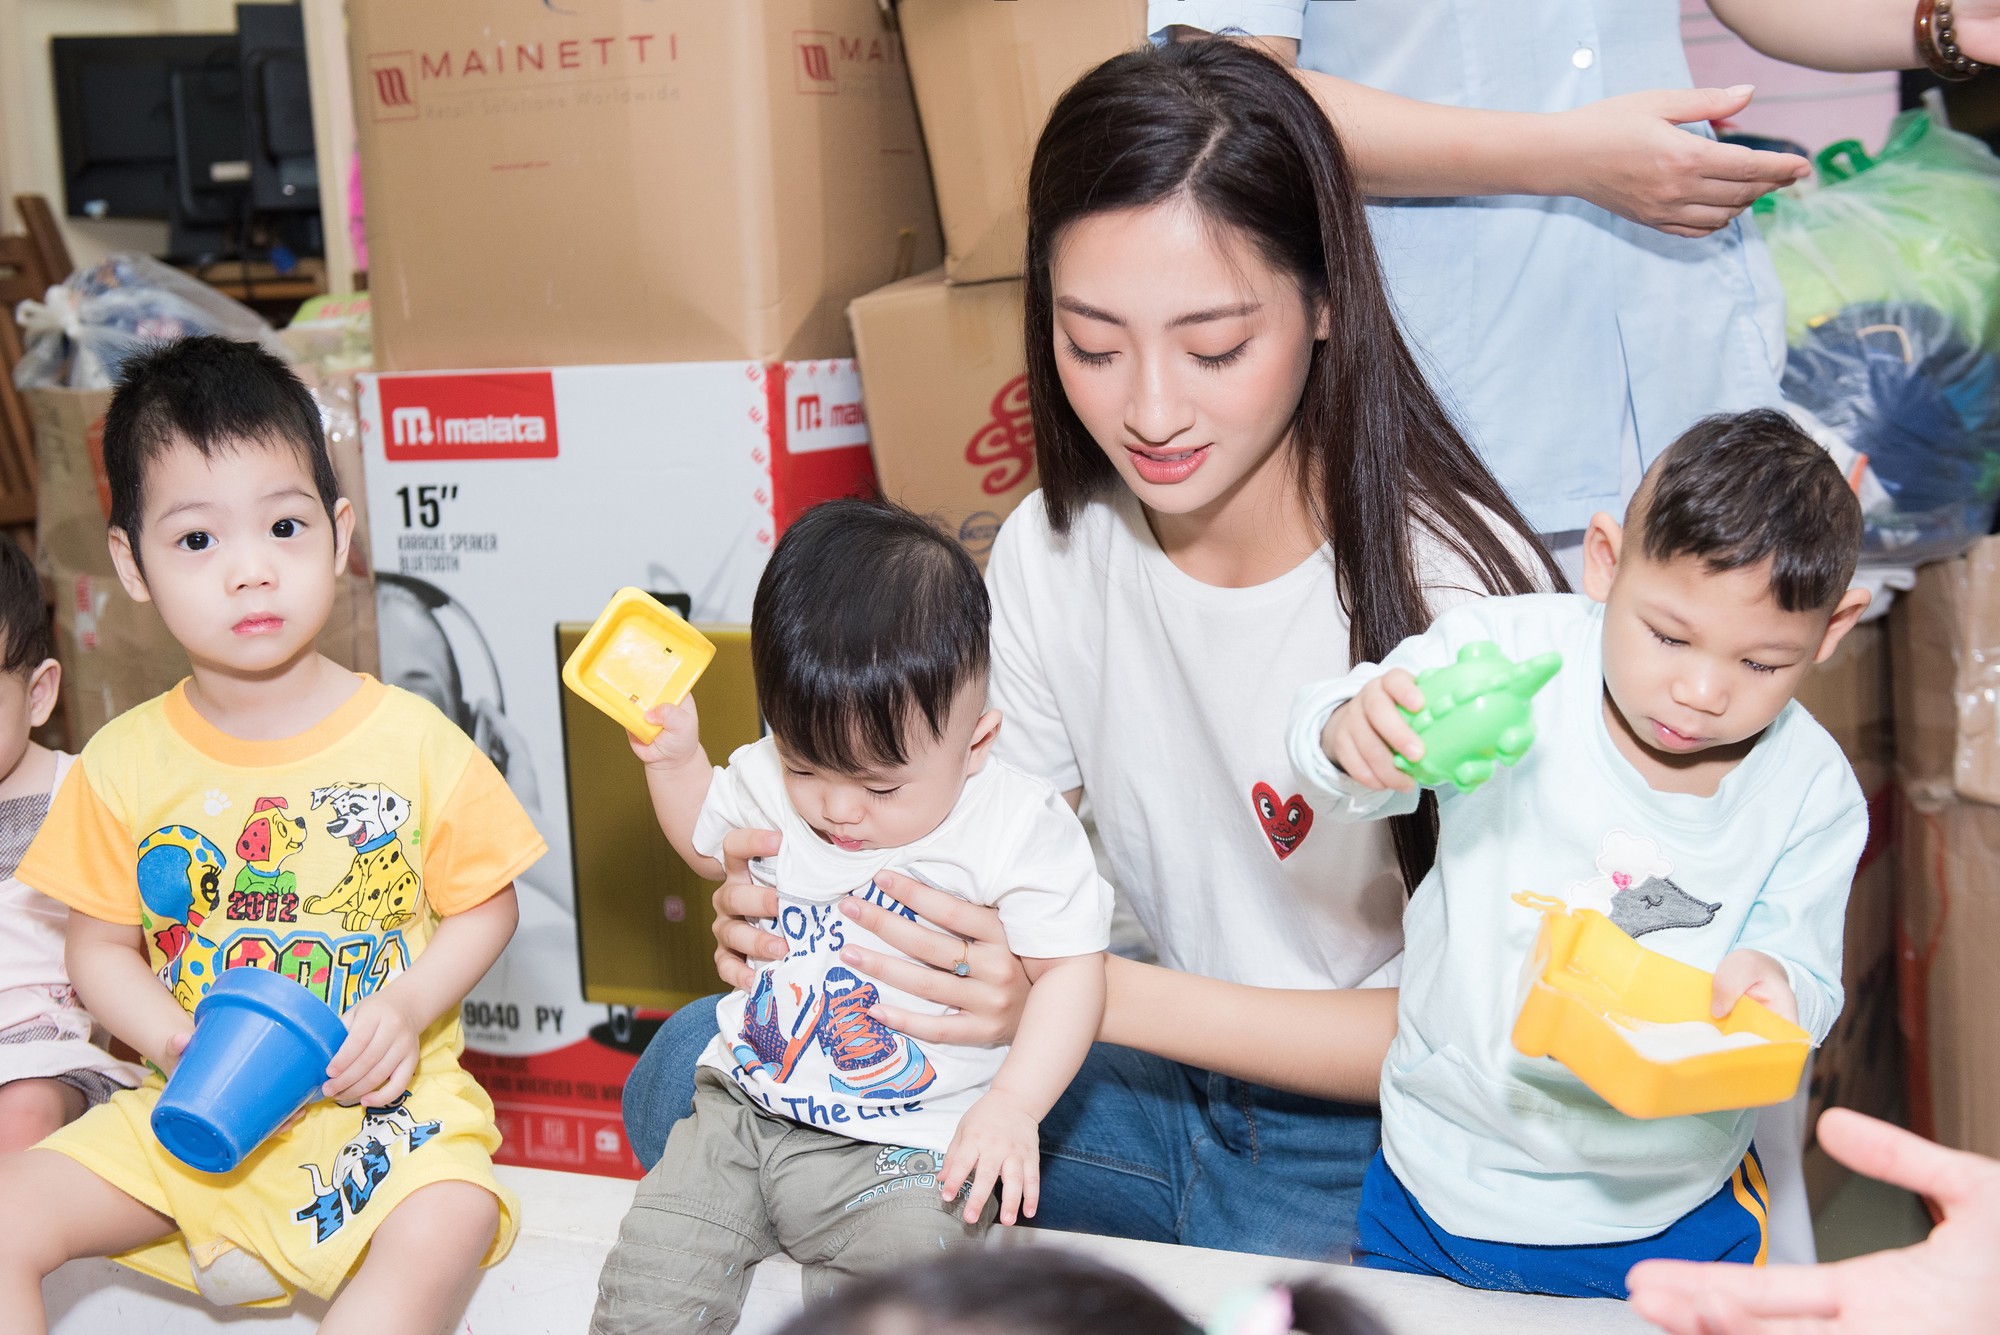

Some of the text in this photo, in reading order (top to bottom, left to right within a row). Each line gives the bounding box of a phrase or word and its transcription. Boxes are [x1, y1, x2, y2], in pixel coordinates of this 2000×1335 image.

[420, 33, 678, 79] MAINETTI
[444, 414, 546, 444] malata
[397, 533, 498, 553] KARAOKE SPEAKER
[399, 555, 460, 573] BLUETOOTH
[226, 891, 299, 923] 2012
[536, 1006, 563, 1032] PY
[781, 1095, 850, 1125] The
